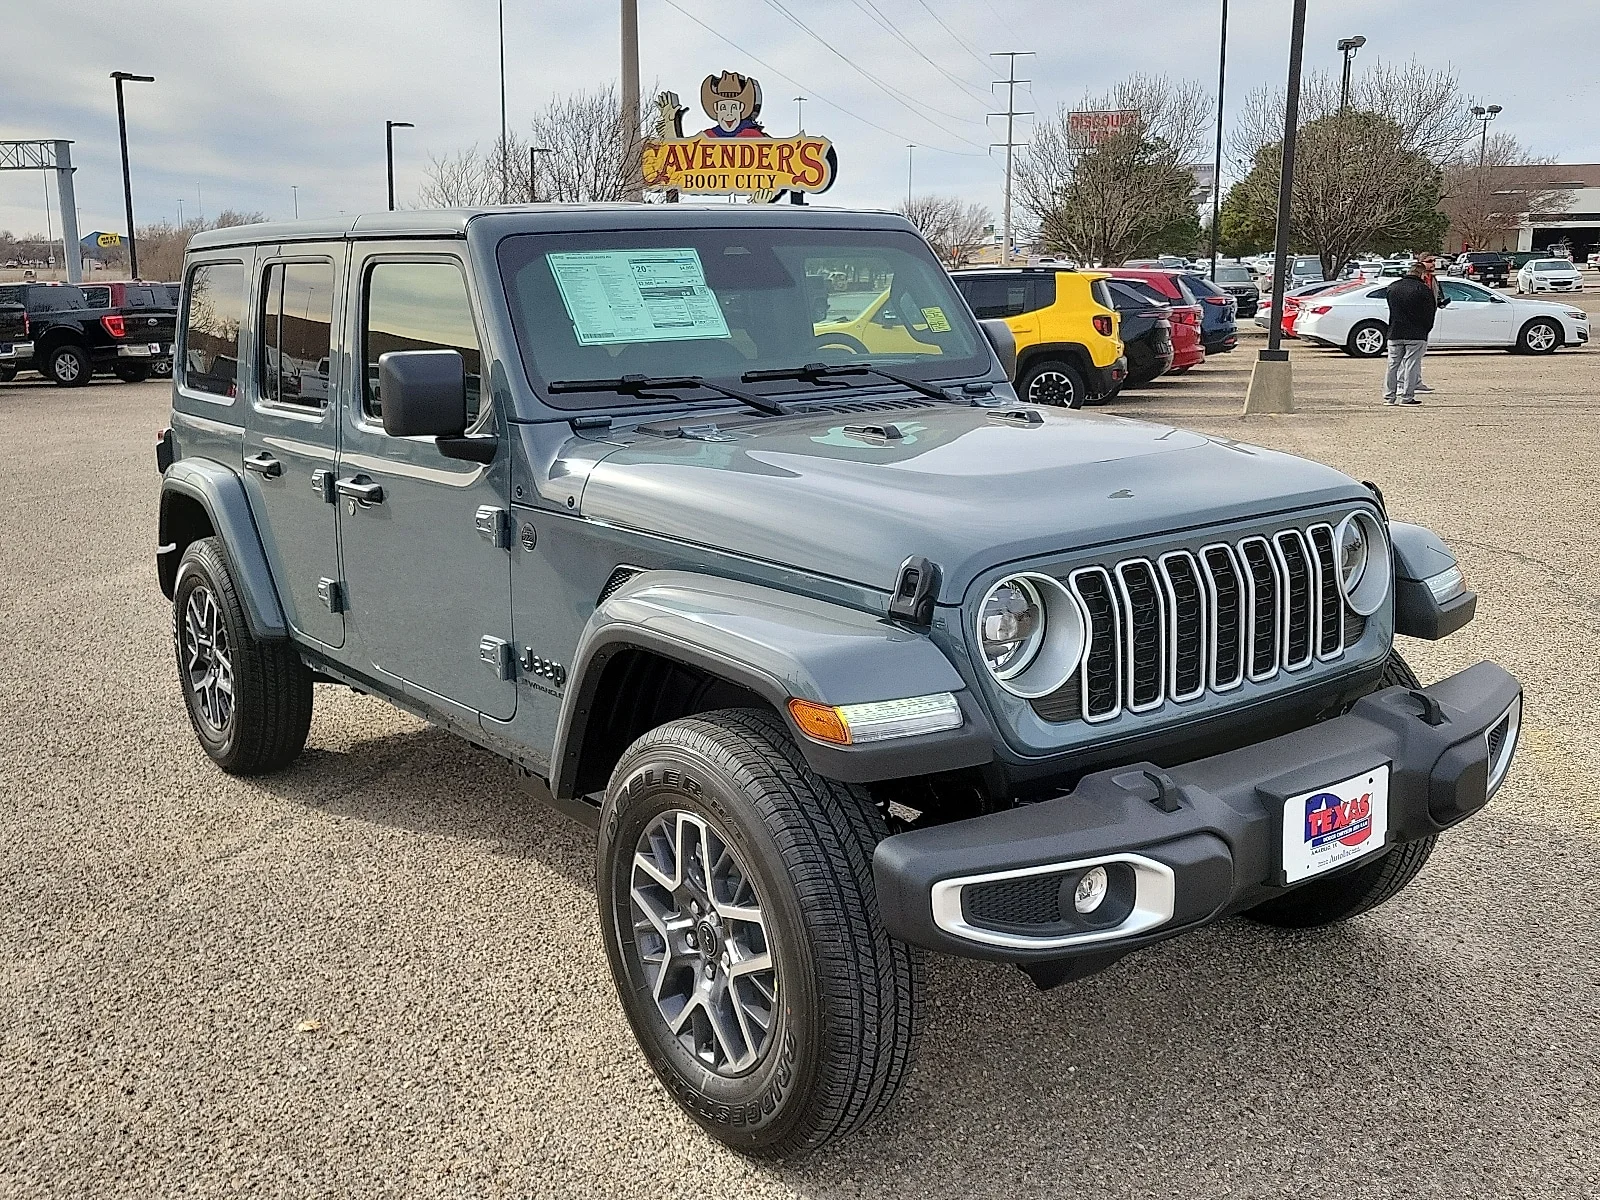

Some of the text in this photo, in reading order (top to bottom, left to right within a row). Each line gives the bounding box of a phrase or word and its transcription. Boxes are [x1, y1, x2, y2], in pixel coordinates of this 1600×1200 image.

[1071, 114, 1137, 128] DISCOU
[642, 139, 825, 187] CAVENDER'S
[684, 174, 777, 189] BOOT CITY
[636, 265, 647, 273] 20
[519, 646, 566, 688] Jeep
[528, 680, 564, 699] WRANGLE
[1308, 793, 1370, 837] TEXAS
[656, 1028, 797, 1127] BRIDGESTONE
